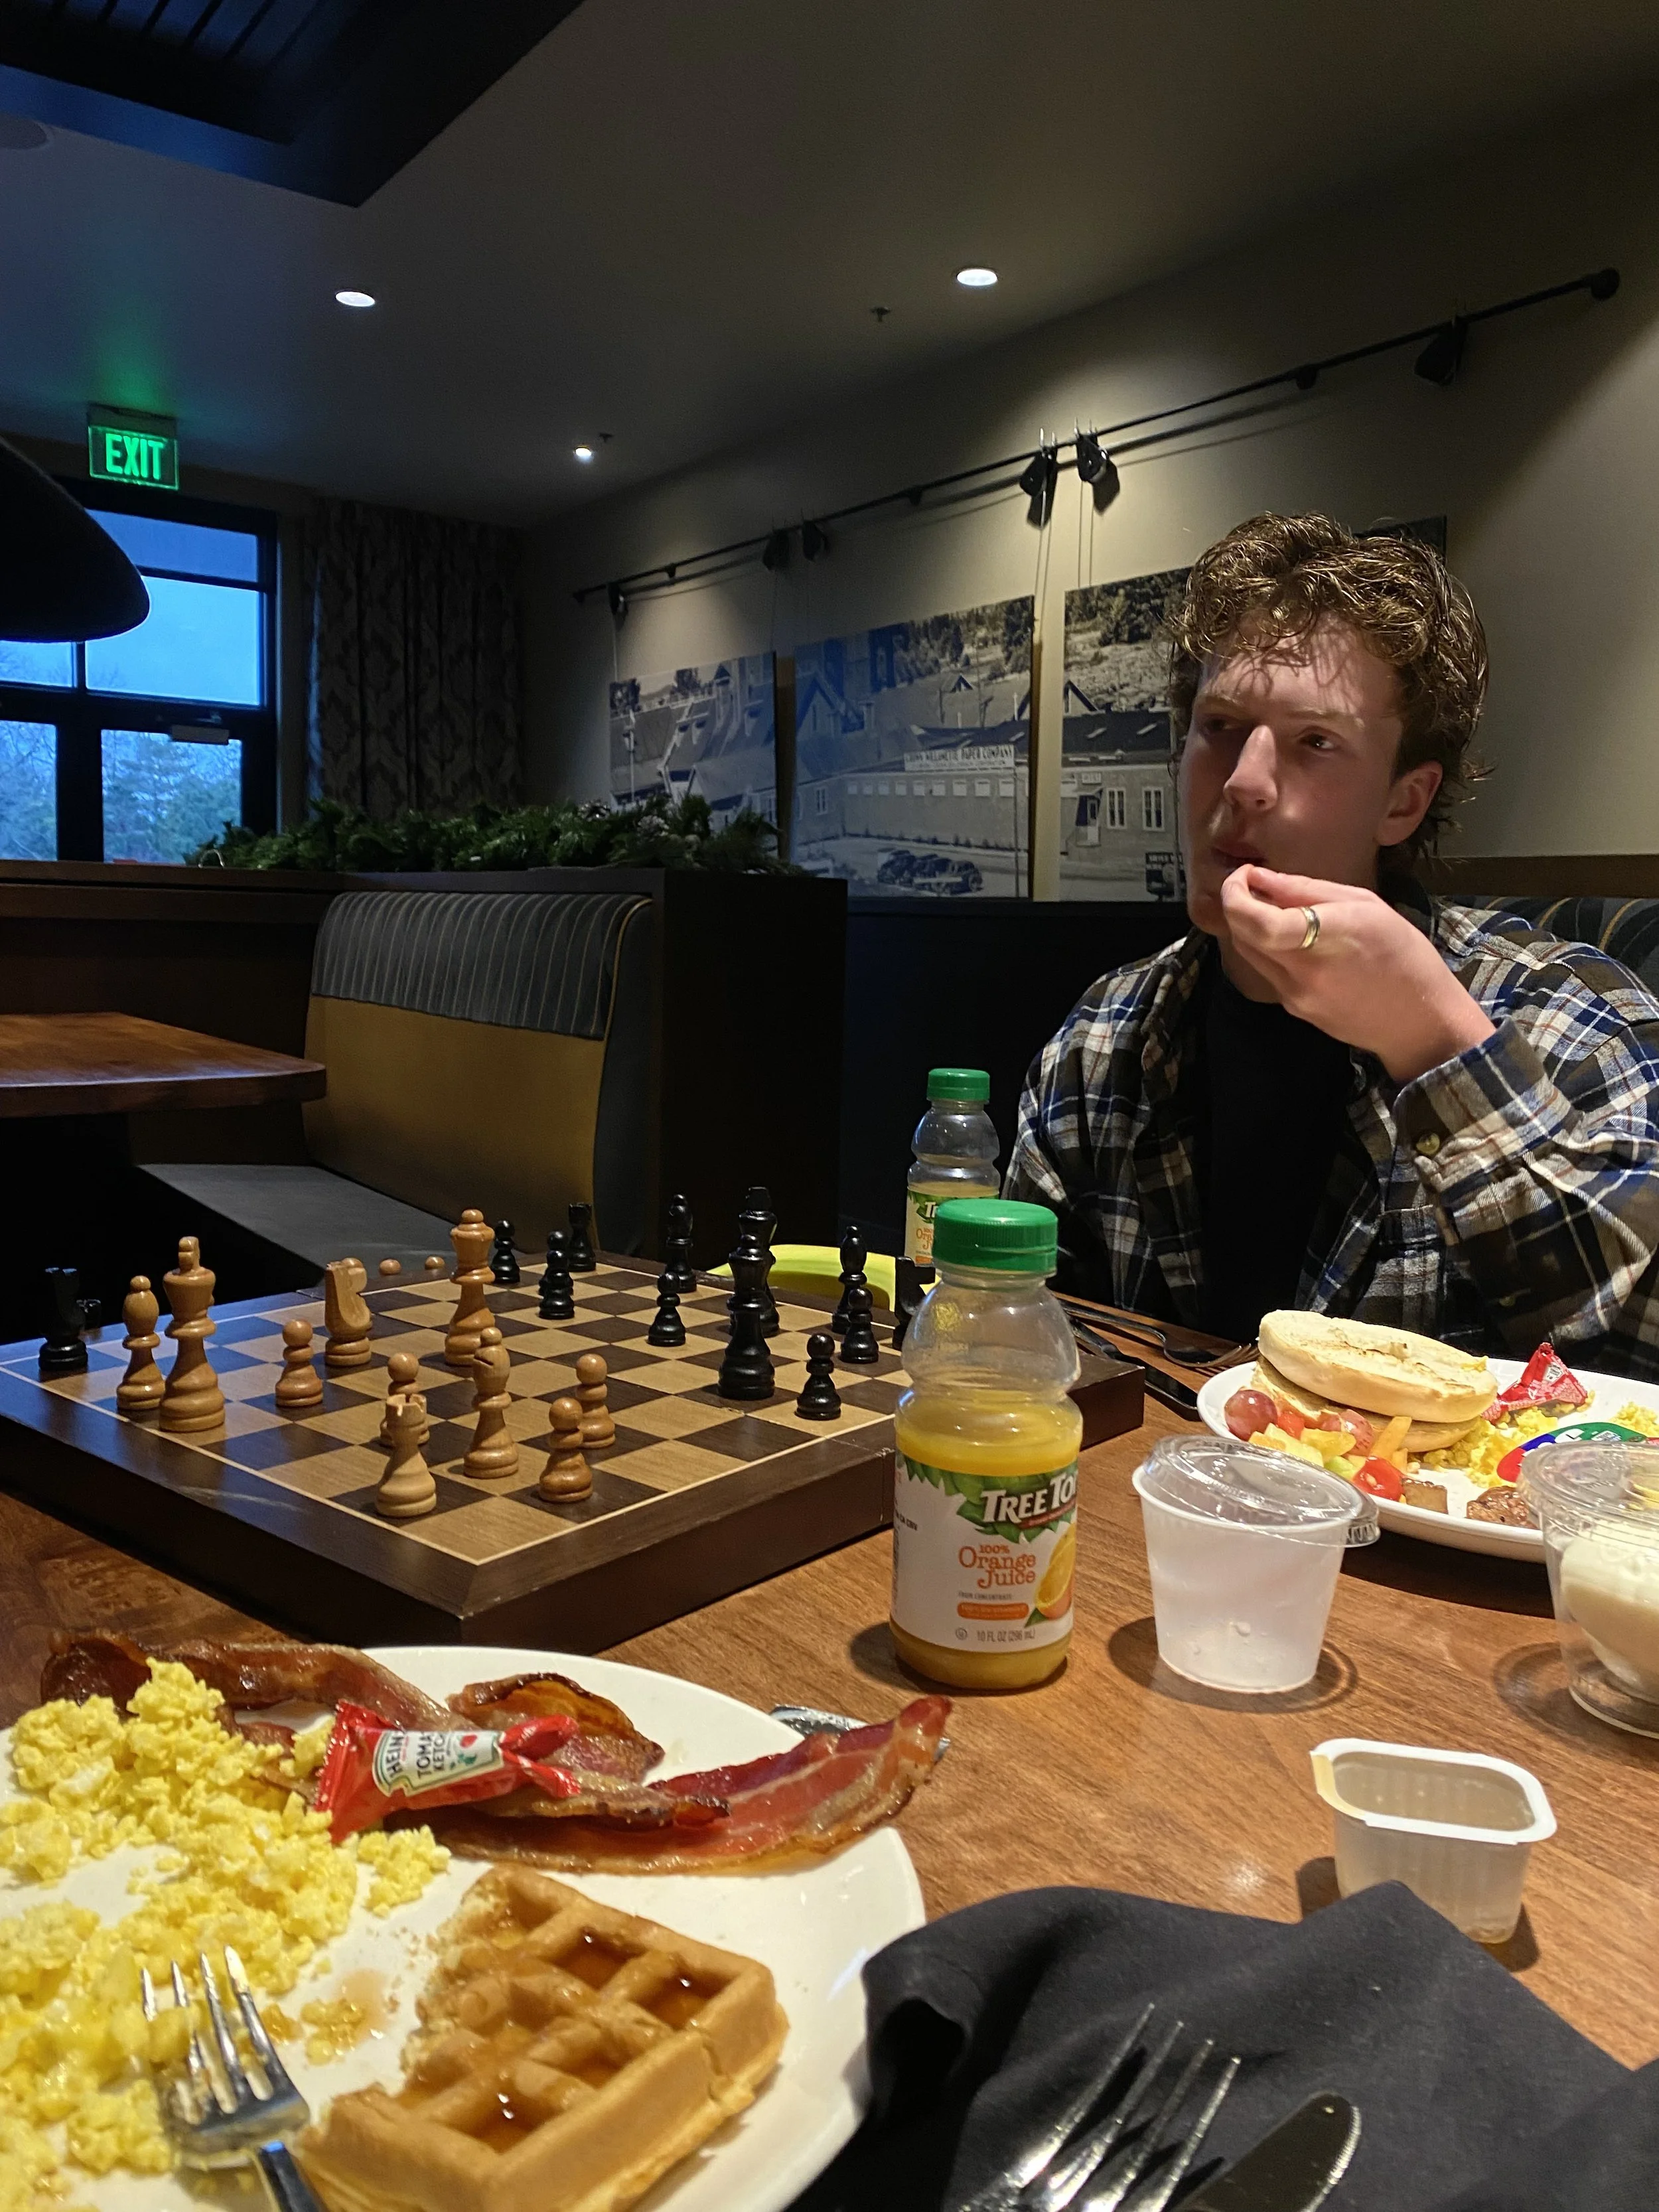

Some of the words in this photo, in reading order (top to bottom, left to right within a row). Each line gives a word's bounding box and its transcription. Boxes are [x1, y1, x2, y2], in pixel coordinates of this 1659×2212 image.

[106, 433, 164, 480] EXIT
[980, 1489, 1048, 1524] TREE
[958, 1545, 1036, 1572] Orange
[979, 1544, 1010, 1554] 100%
[977, 1568, 1036, 1589] Juice
[977, 1629, 986, 1642] 10
[386, 1732, 404, 1777] HEIN
[416, 1732, 433, 1779] TOMA
[433, 1732, 445, 1772] KETC
